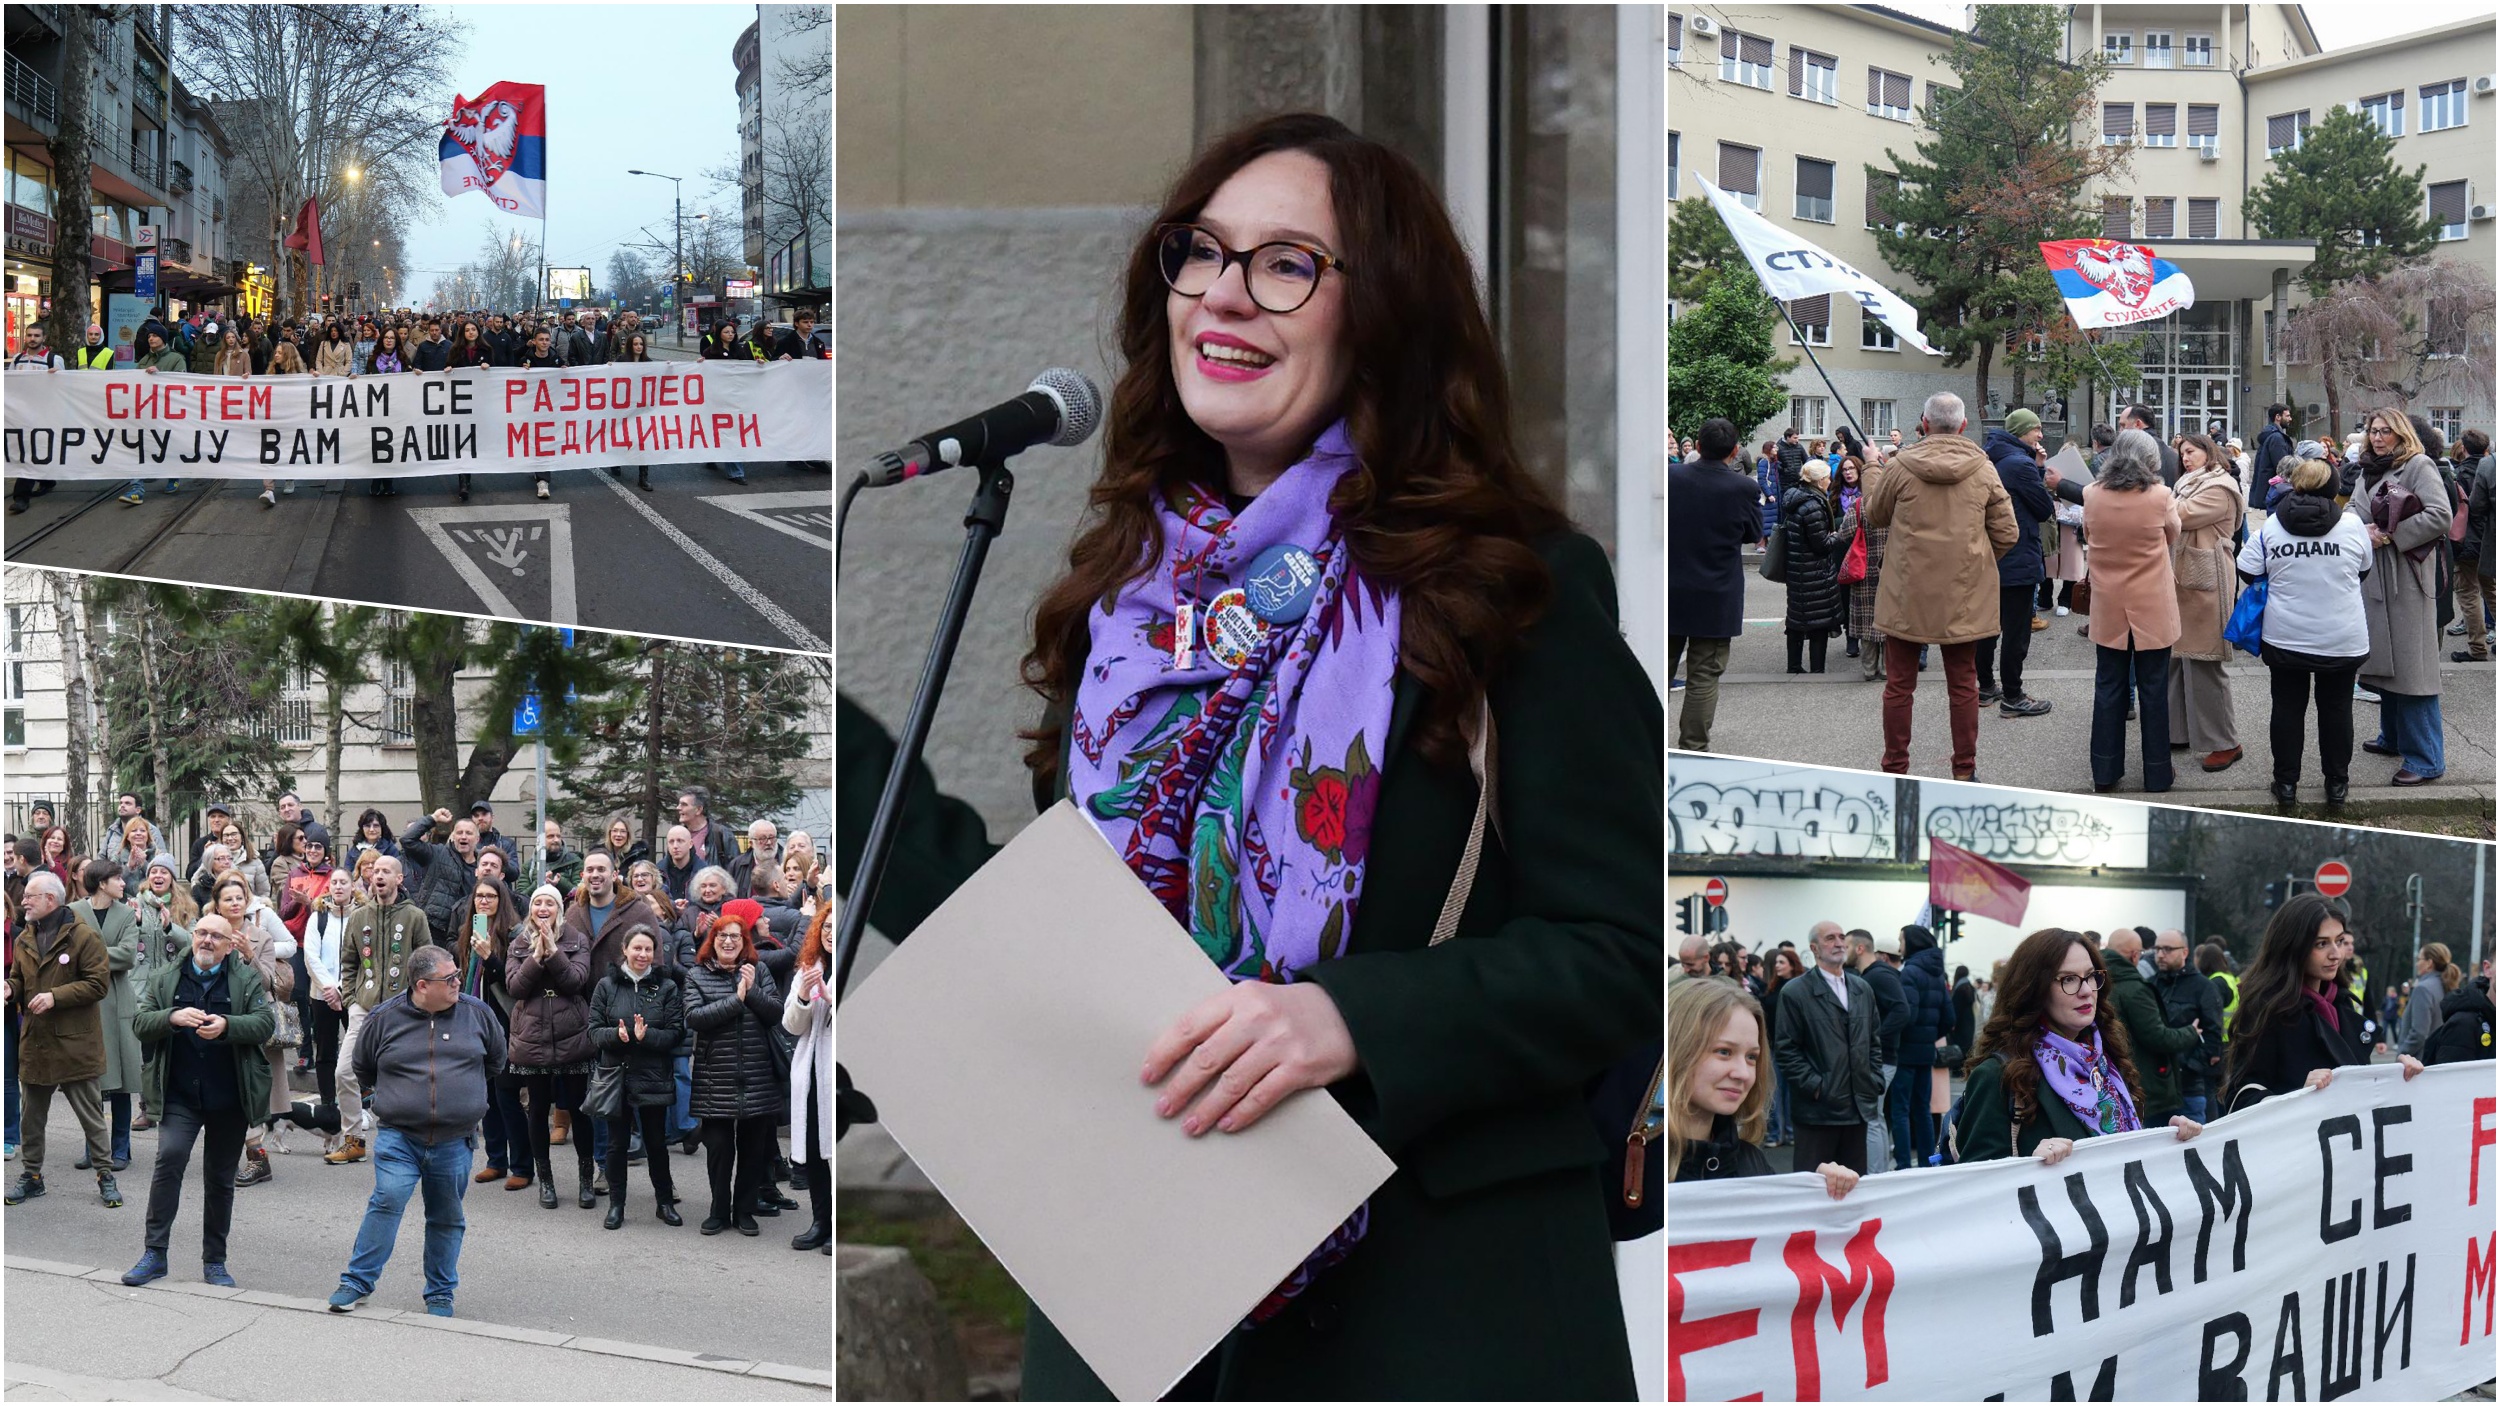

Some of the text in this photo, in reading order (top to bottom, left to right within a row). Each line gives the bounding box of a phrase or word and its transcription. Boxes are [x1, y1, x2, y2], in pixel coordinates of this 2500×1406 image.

[2103, 297, 2178, 323] СТУДЕНТЕ
[105, 374, 705, 421] СИСТЕМ НАМ СЕ РАЗБОЛЕО
[258, 427, 340, 465] ВАМ
[371, 423, 478, 465] ВАШИ
[507, 413, 763, 459] МЕДИЦИНАРИ
[2270, 541, 2341, 561] ХОДАМ
[1225, 606, 1258, 645] ЦВЕТНАЯ
[2017, 1139, 2253, 1338] НАМ
[2317, 1104, 2413, 1246] СЕ
[2197, 1252, 2417, 1402] ВАШИ
